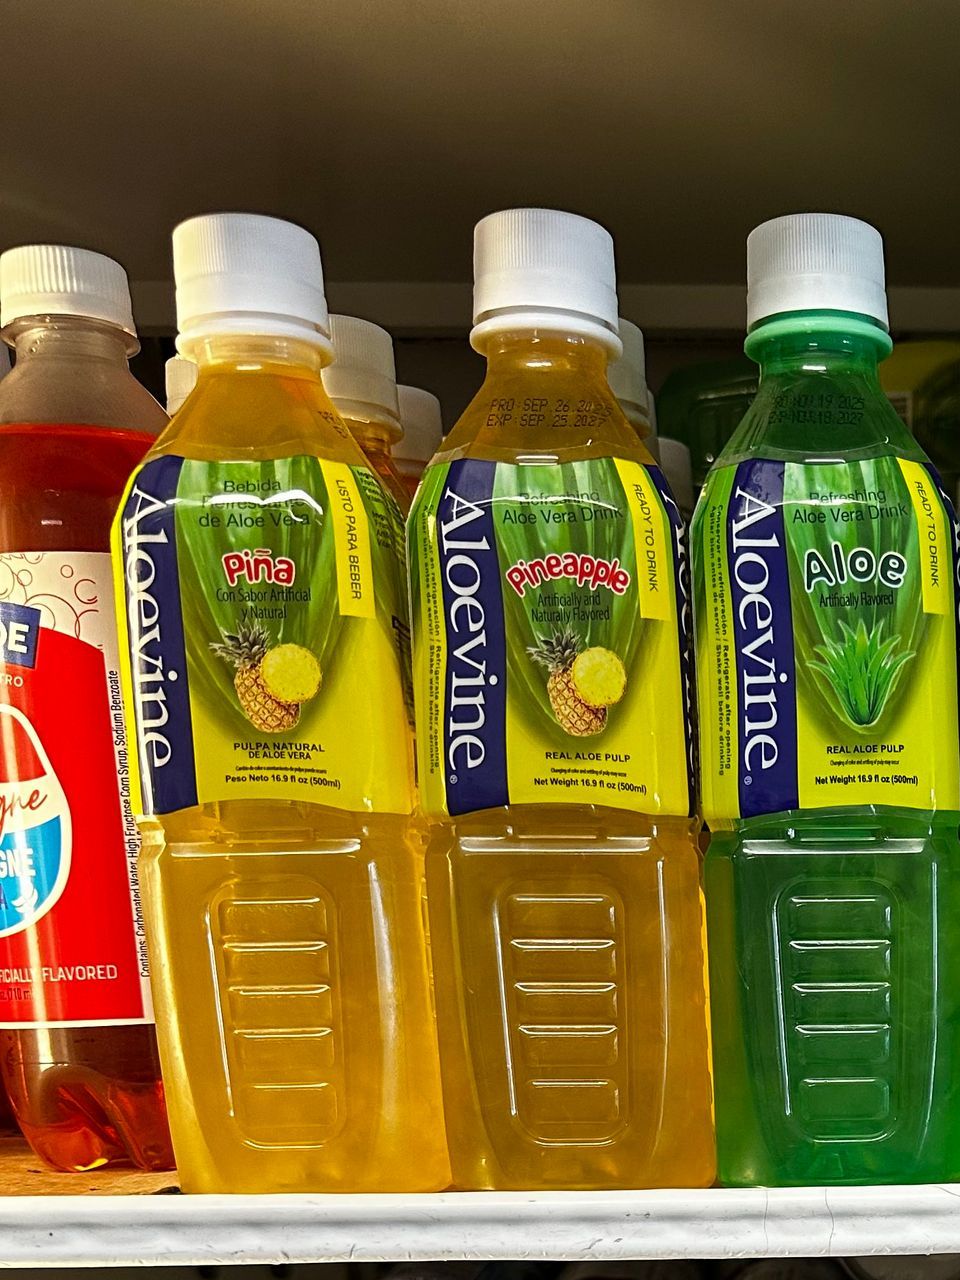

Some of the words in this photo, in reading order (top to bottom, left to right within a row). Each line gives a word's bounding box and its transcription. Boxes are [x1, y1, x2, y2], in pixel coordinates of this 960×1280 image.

[223, 479, 281, 493] Bebida
[336, 479, 354, 512] LISTO
[503, 511, 536, 525] Aloe
[542, 509, 577, 523] Vera
[583, 505, 623, 522] Drink
[792, 508, 827, 524] Aloe
[830, 505, 865, 522] Vera
[868, 502, 908, 520] Drink
[914, 481, 935, 523] READY
[199, 514, 220, 527] de
[226, 513, 264, 527] Aloe
[345, 516, 358, 550] PARA
[927, 523, 937, 542] TO
[222, 549, 295, 587] Piña
[349, 556, 362, 600] BEBER
[506, 552, 631, 598] Pineapple
[804, 541, 907, 593] Aloe
[929, 545, 939, 588] DRINK
[216, 589, 236, 602] Con
[238, 589, 268, 602] Sabor
[270, 588, 311, 602] Artificial
[537, 592, 580, 607] Artificially
[582, 592, 601, 605] and
[819, 593, 859, 608] Artificially
[860, 591, 894, 606] Flavored
[121, 484, 179, 768] Aloevine
[441, 486, 498, 771] Aloevine
[531, 608, 571, 623] Naturally
[572, 607, 610, 621] Flavored
[731, 486, 788, 771] Aloevine
[110, 670, 121, 712] Benzoate
[114, 712, 125, 746] Sodium
[116, 747, 129, 776] Syrup,
[273, 743, 325, 752] NATURAL
[290, 752, 311, 760] VERA
[545, 751, 573, 761] REAL
[575, 752, 602, 761] ALOE
[605, 752, 631, 763] PULP
[826, 745, 851, 754] REAL
[853, 744, 879, 753] ALOE
[880, 744, 904, 753] PULP
[120, 777, 130, 799] Corn
[124, 800, 136, 837] Fructose
[124, 837, 137, 858] High
[130, 859, 139, 888] Water,
[133, 887, 144, 936] Carbonated
[140, 938, 150, 978] Contains:
